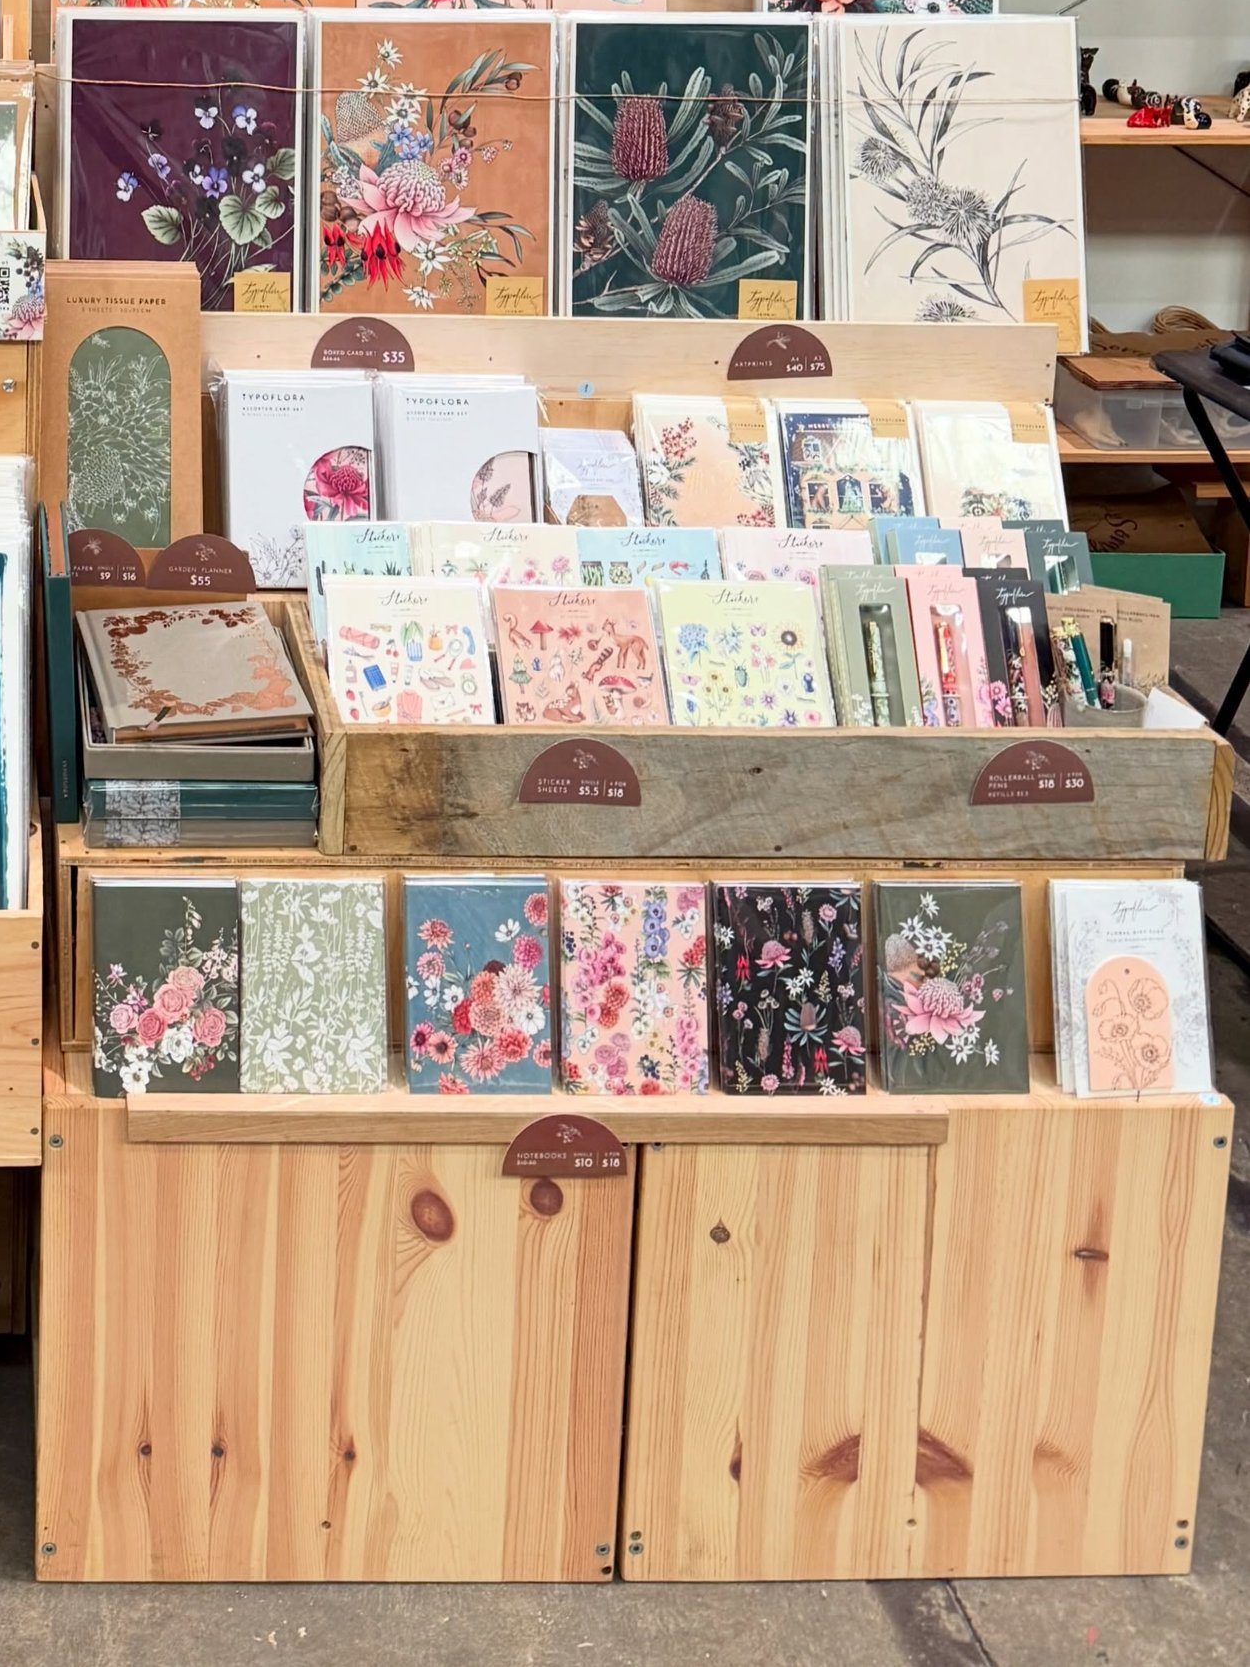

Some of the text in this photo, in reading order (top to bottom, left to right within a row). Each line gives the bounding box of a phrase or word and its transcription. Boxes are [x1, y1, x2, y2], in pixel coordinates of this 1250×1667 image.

[105, 297, 135, 305] TISSUE
[382, 351, 406, 363] $35
[786, 362, 826, 372] $40 $75
[242, 393, 305, 401] TYPOFLORA
[406, 398, 469, 406] TYPOFLORA
[355, 527, 400, 544] Stickers
[483, 527, 528, 542] Stickers
[621, 531, 667, 547] Stickers
[777, 533, 825, 549] Stickers
[100, 572, 137, 581] $9 $16
[190, 575, 211, 586] $55
[381, 589, 428, 607] Stickers
[548, 590, 597, 608] Stickers
[707, 588, 760, 604] Stickers
[538, 778, 570, 786] STICKER
[1038, 778, 1084, 789] $18 $30
[537, 786, 568, 794] SHEETS
[578, 786, 624, 797] $5.5 $18
[574, 1158, 620, 1168] $10 $18
